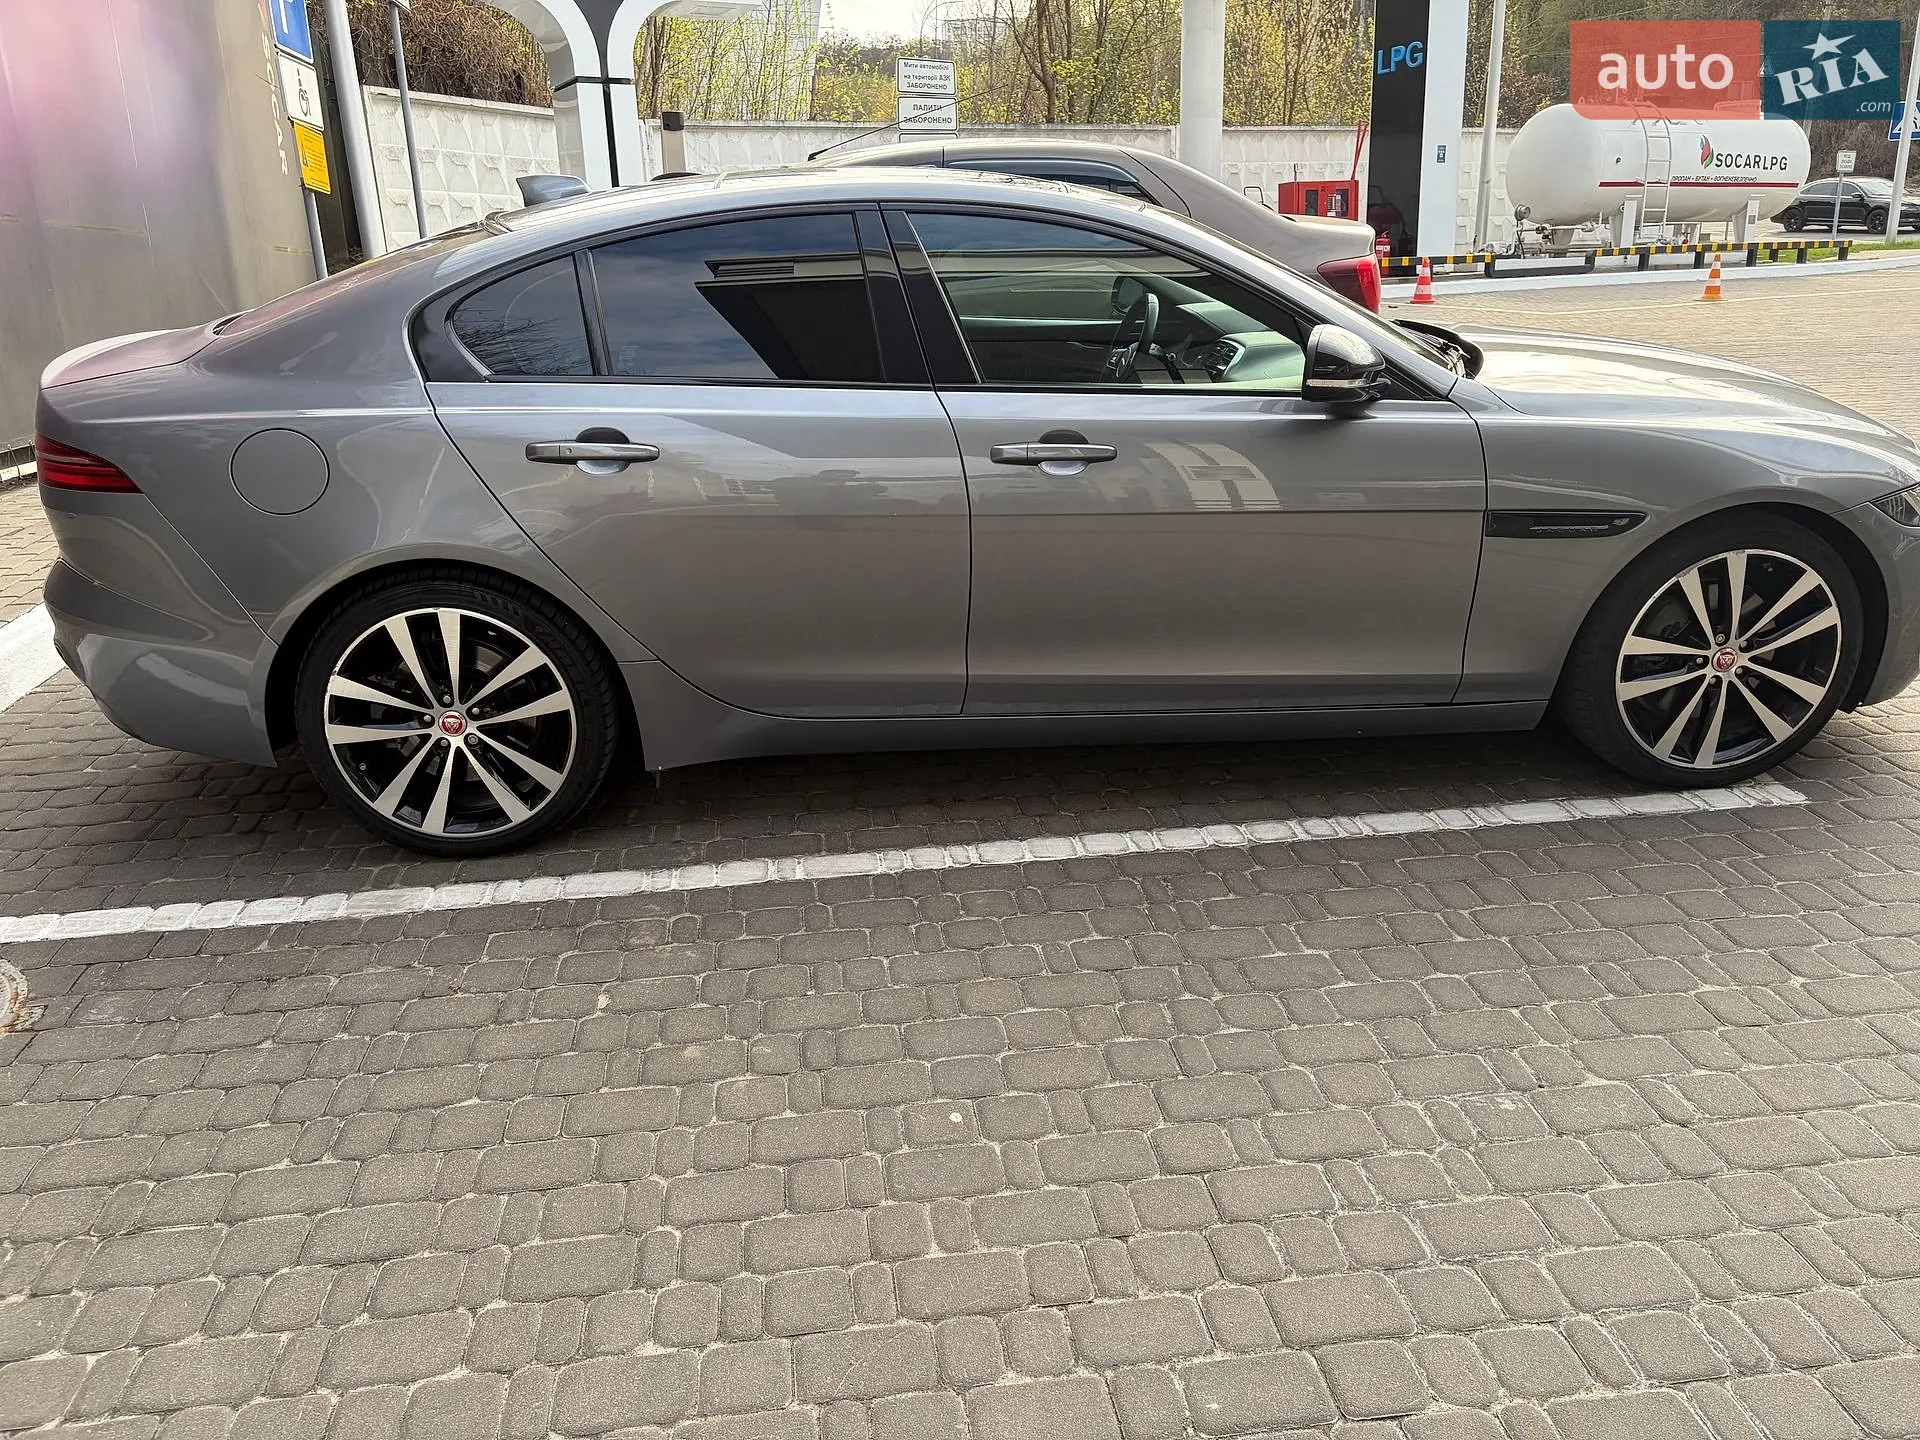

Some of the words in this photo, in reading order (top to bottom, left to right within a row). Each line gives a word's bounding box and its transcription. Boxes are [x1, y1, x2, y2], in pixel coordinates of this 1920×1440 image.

[1377, 41, 1424, 75] LPG
[907, 82, 947, 90] ЗАБОРОНЕНО
[939, 74, 951, 82] АЗК
[262, 33, 288, 175] SOCAR
